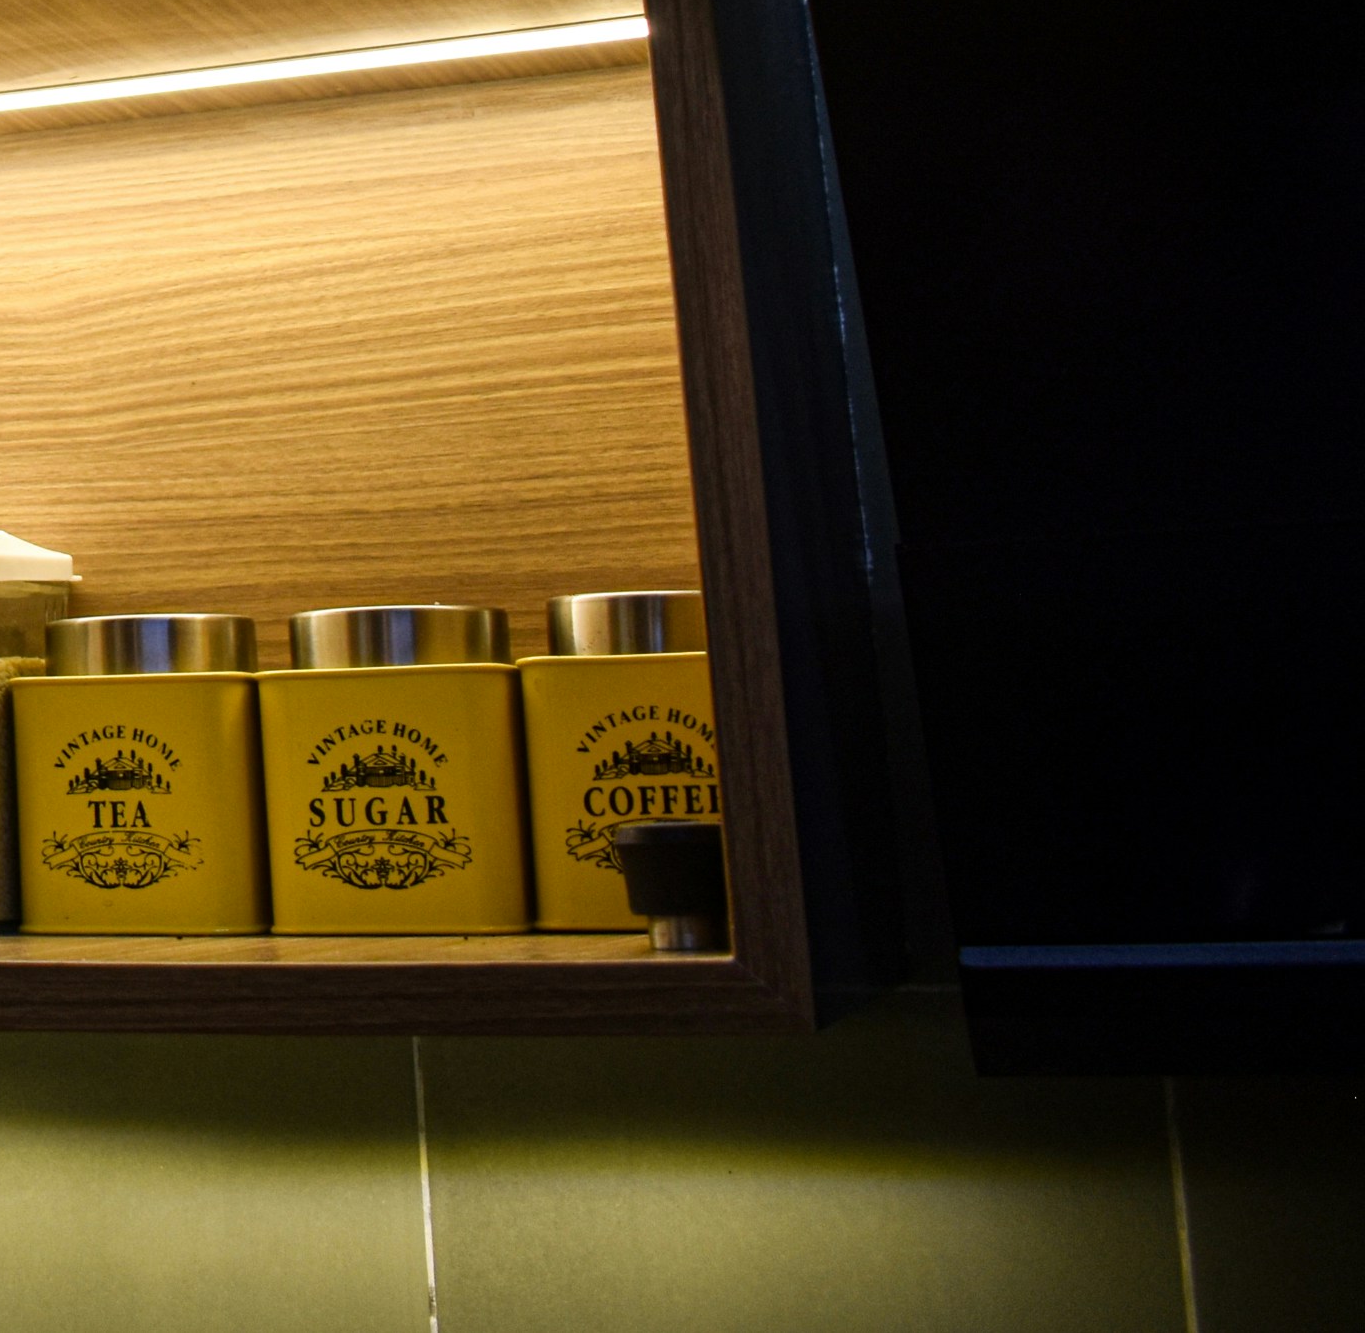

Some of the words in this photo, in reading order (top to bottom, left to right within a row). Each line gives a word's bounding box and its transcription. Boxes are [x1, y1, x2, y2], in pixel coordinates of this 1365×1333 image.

[53, 725, 127, 771] VINTAGE
[131, 726, 183, 772] HOME
[306, 719, 387, 767] VINTAGE
[392, 722, 449, 768] HOME
[576, 705, 660, 754] VINTAGE
[666, 707, 717, 750] HOM
[87, 800, 152, 829] TEA
[308, 795, 450, 827] SUGAR
